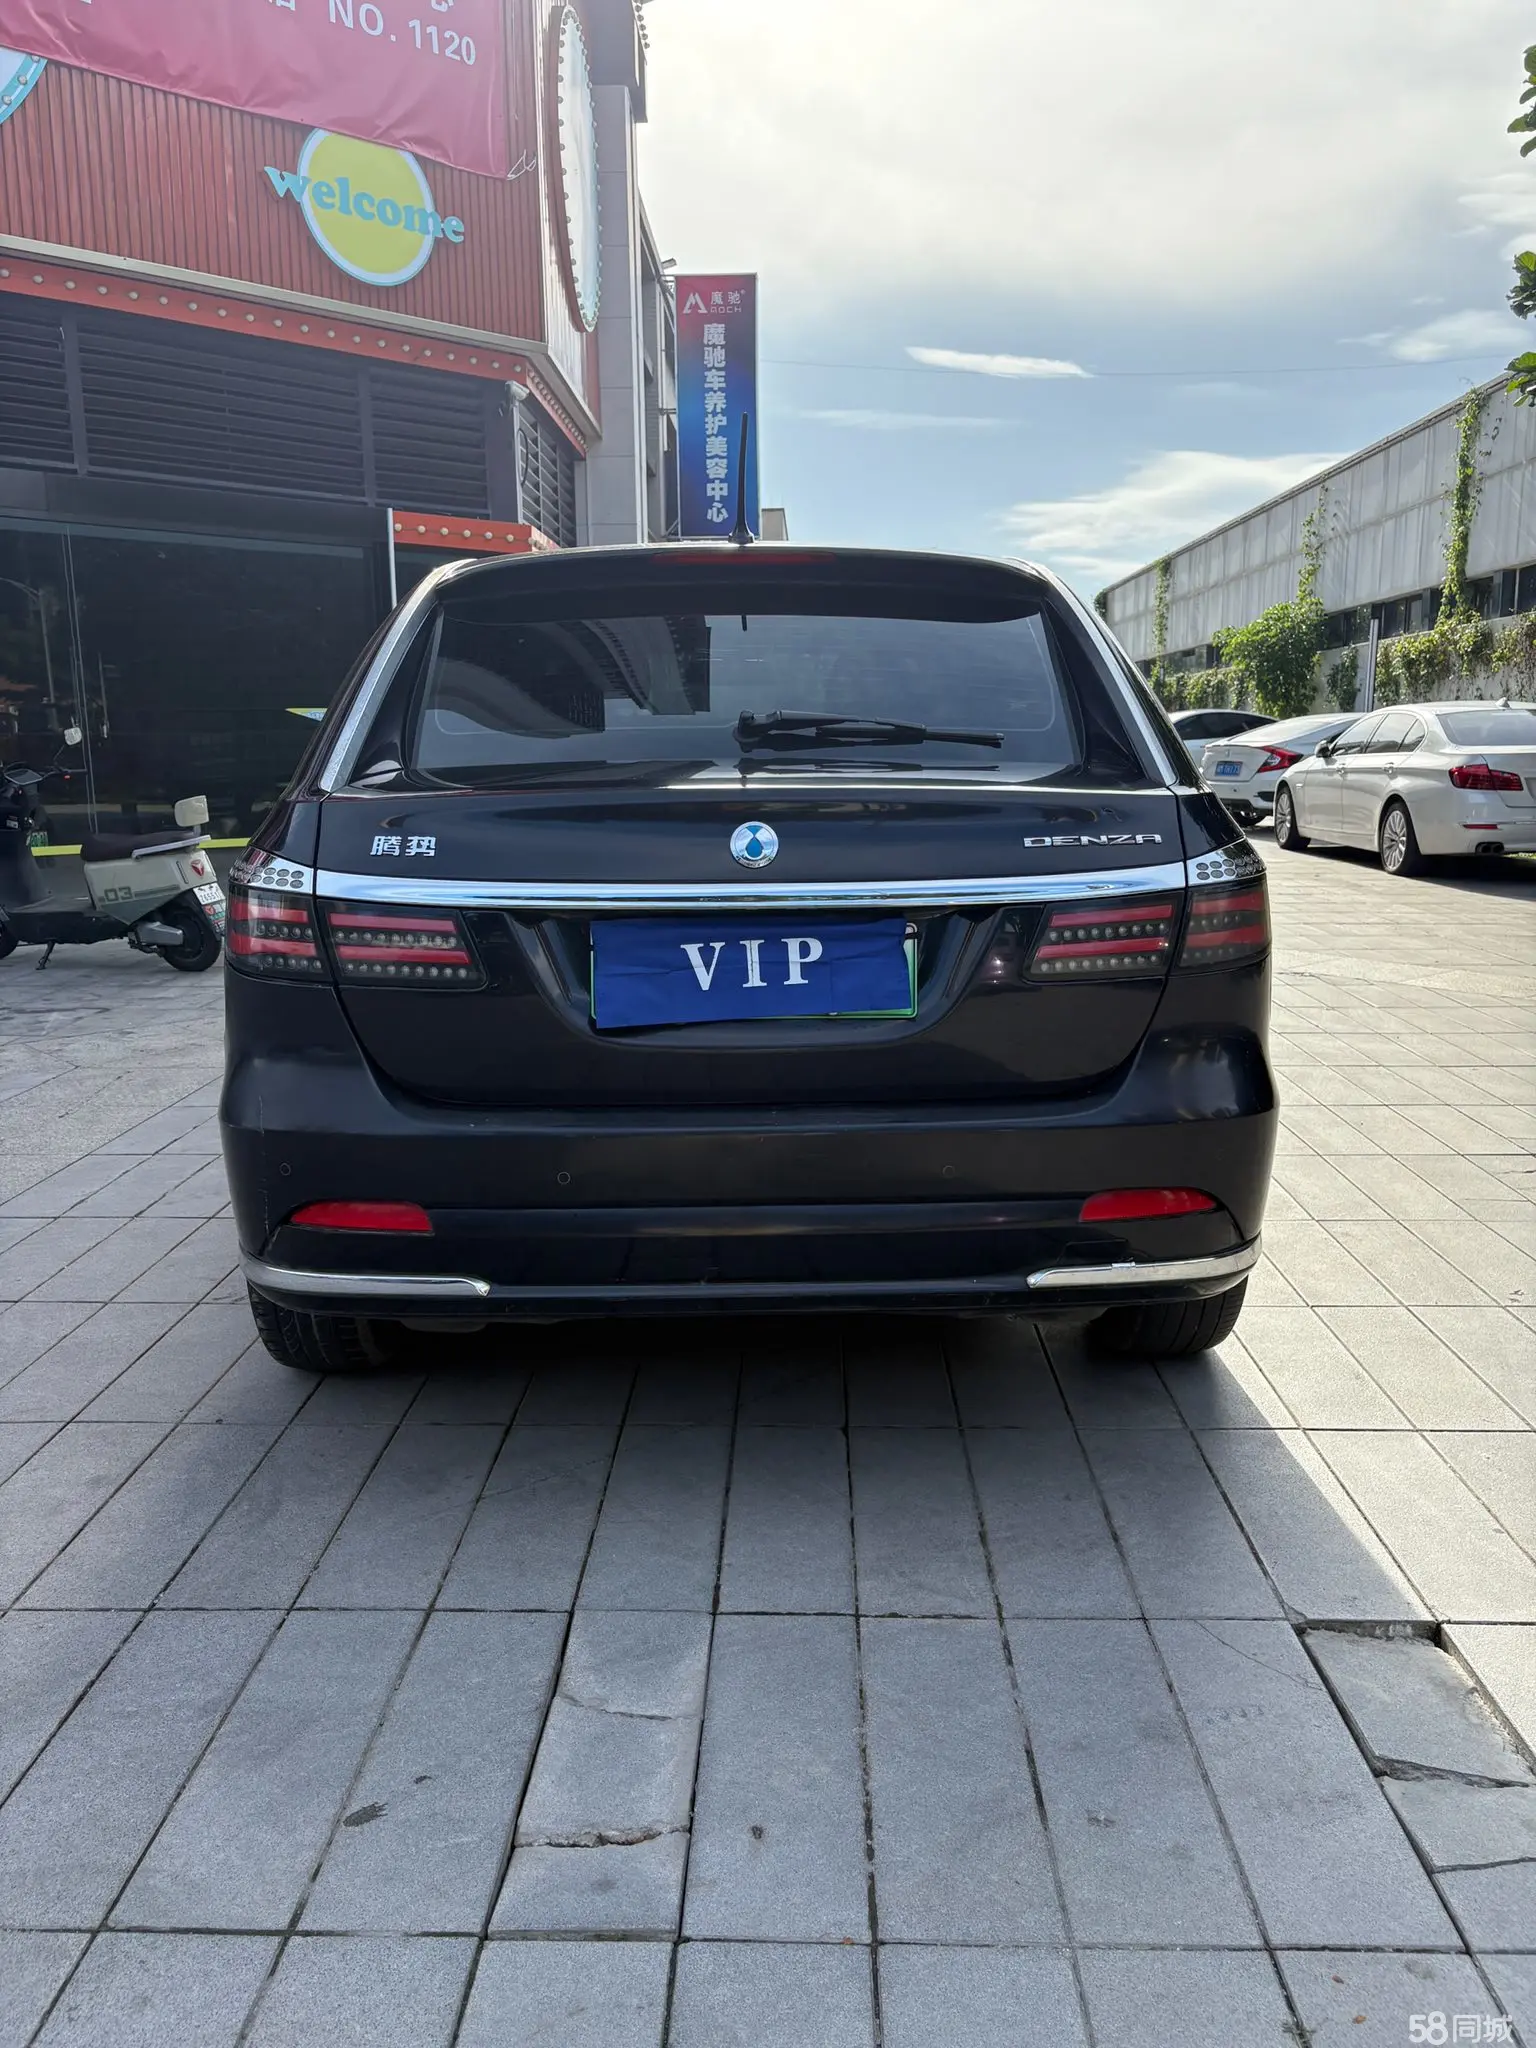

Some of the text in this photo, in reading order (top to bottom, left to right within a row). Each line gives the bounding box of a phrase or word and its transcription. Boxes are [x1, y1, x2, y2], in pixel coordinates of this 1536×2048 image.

[408, 18, 476, 66] 1120
[264, 166, 465, 243] welcome
[703, 323, 729, 523] 魔驰车养护美容中心
[370, 835, 437, 857] 腾势
[1023, 834, 1163, 848] DENZA
[680, 937, 823, 991] VIP
